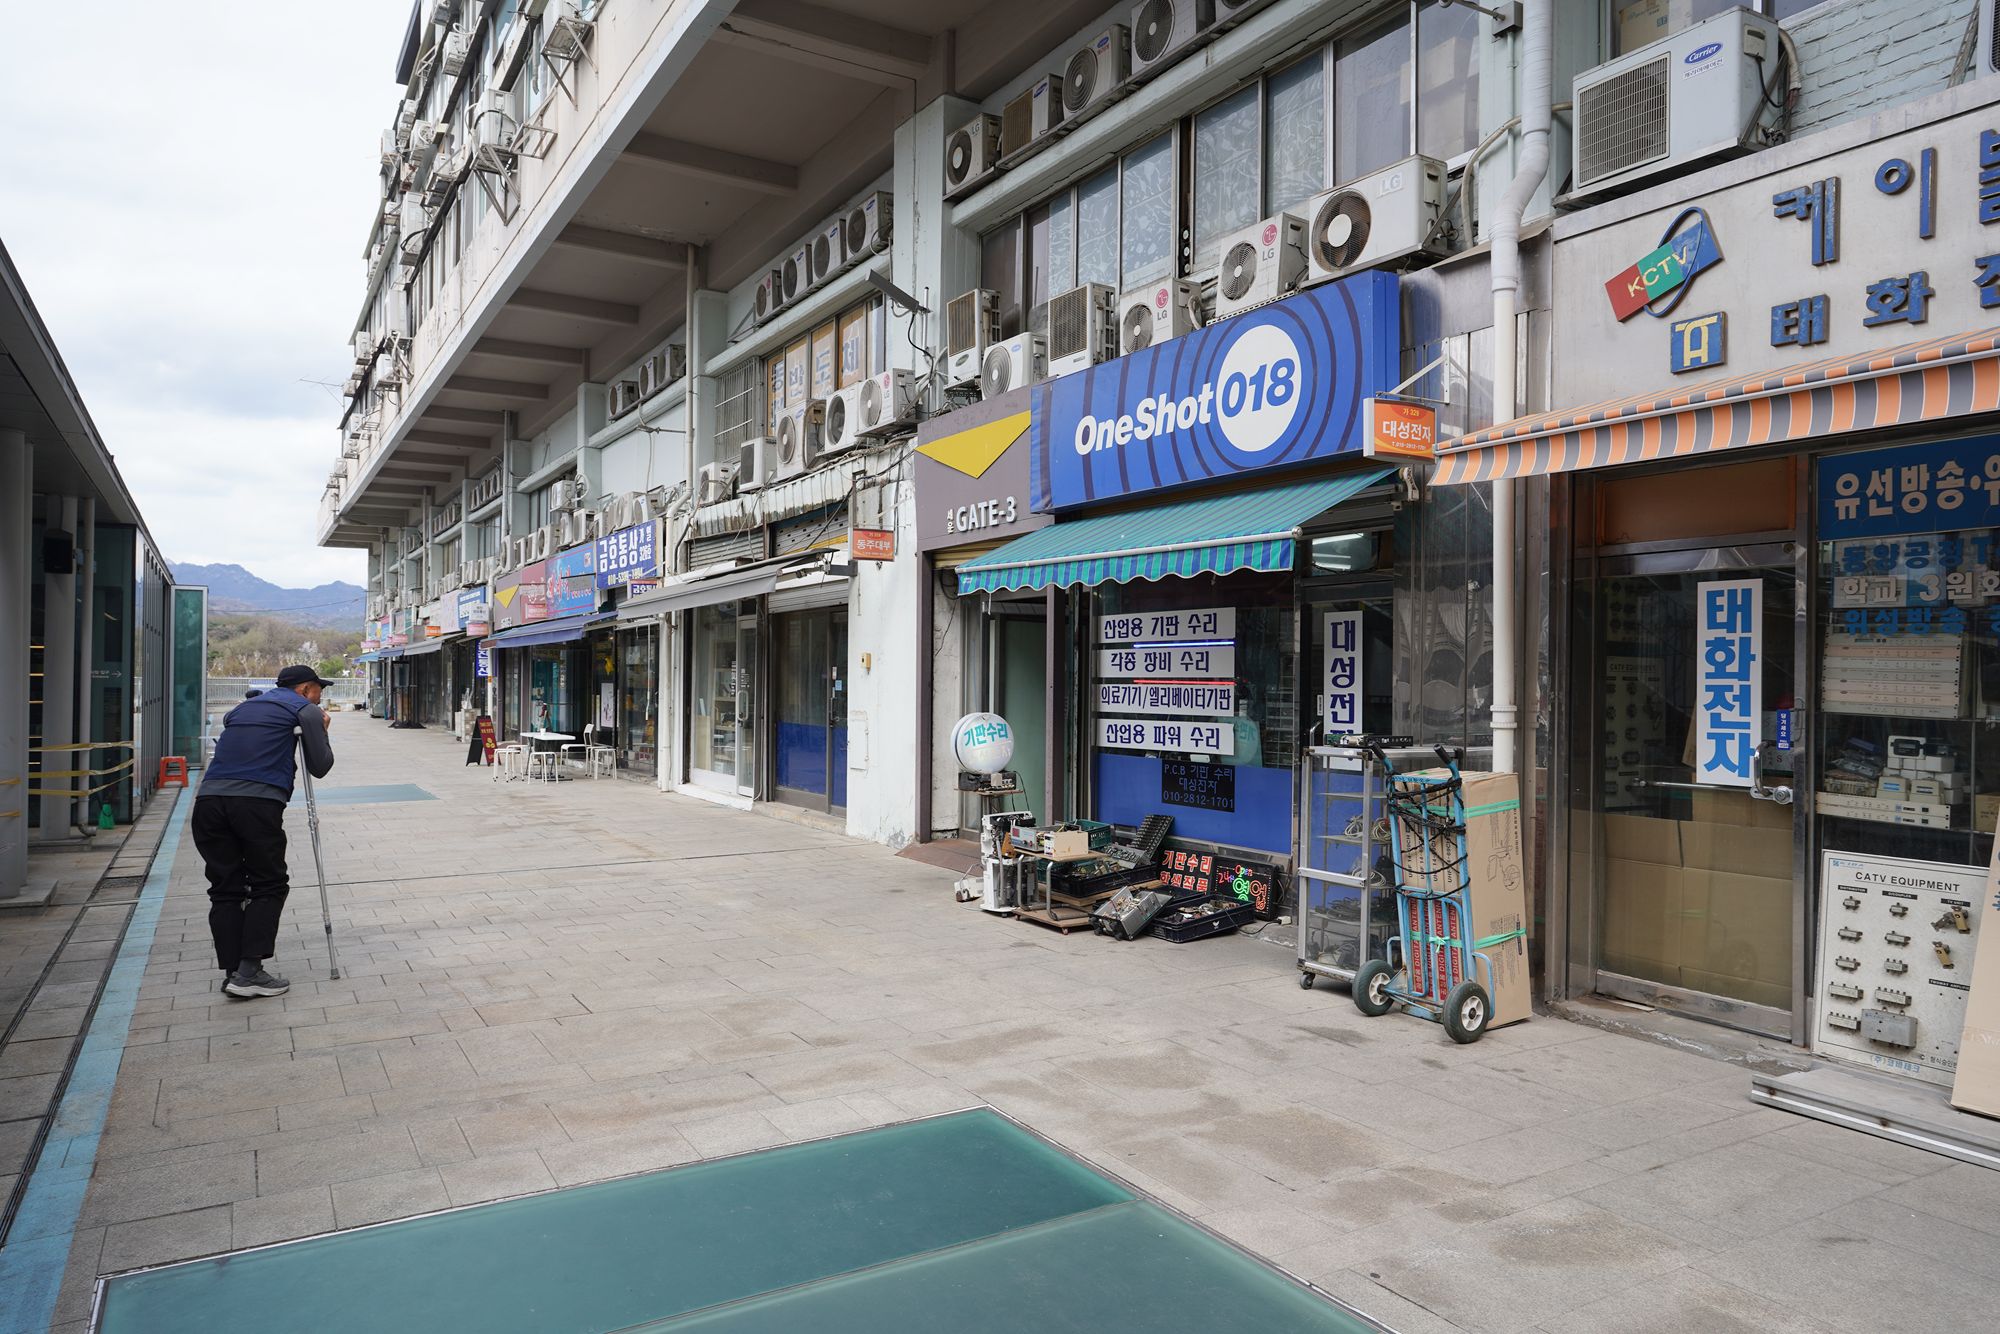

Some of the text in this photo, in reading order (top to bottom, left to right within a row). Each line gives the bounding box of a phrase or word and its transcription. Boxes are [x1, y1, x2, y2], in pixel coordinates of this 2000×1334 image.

[1688, 45, 1719, 62] Carrier
[971, 123, 980, 136] LG
[1381, 175, 1401, 194] LG
[1262, 248, 1275, 262] LG
[1627, 245, 1688, 298] KCTV
[1157, 309, 1168, 321] LG
[1075, 357, 1296, 456] OneShot 018
[1382, 420, 1432, 444] 대성전자
[956, 496, 1018, 533] GATE-3
[599, 528, 638, 573] 금호통상
[1843, 575, 1897, 604] 학교
[1104, 612, 1217, 640] 산업용 기판 수리
[1844, 605, 1969, 636] 위성방송
[1110, 651, 1210, 673] 각종 장비 수리
[1330, 620, 1356, 736] 대성전
[1703, 588, 1756, 778] 태화전자
[1101, 685, 1231, 711] 의료기기/엘리베이터기판
[963, 722, 1009, 747] 기판수리
[1106, 723, 1220, 750] 산업용 파워 수리
[1164, 763, 1233, 782] P.C.B 기판 수리
[1163, 790, 1234, 809] 010-2812-1701
[1162, 849, 1213, 875] 기판수리
[1855, 871, 1960, 892] CATV EQUIPMENT
